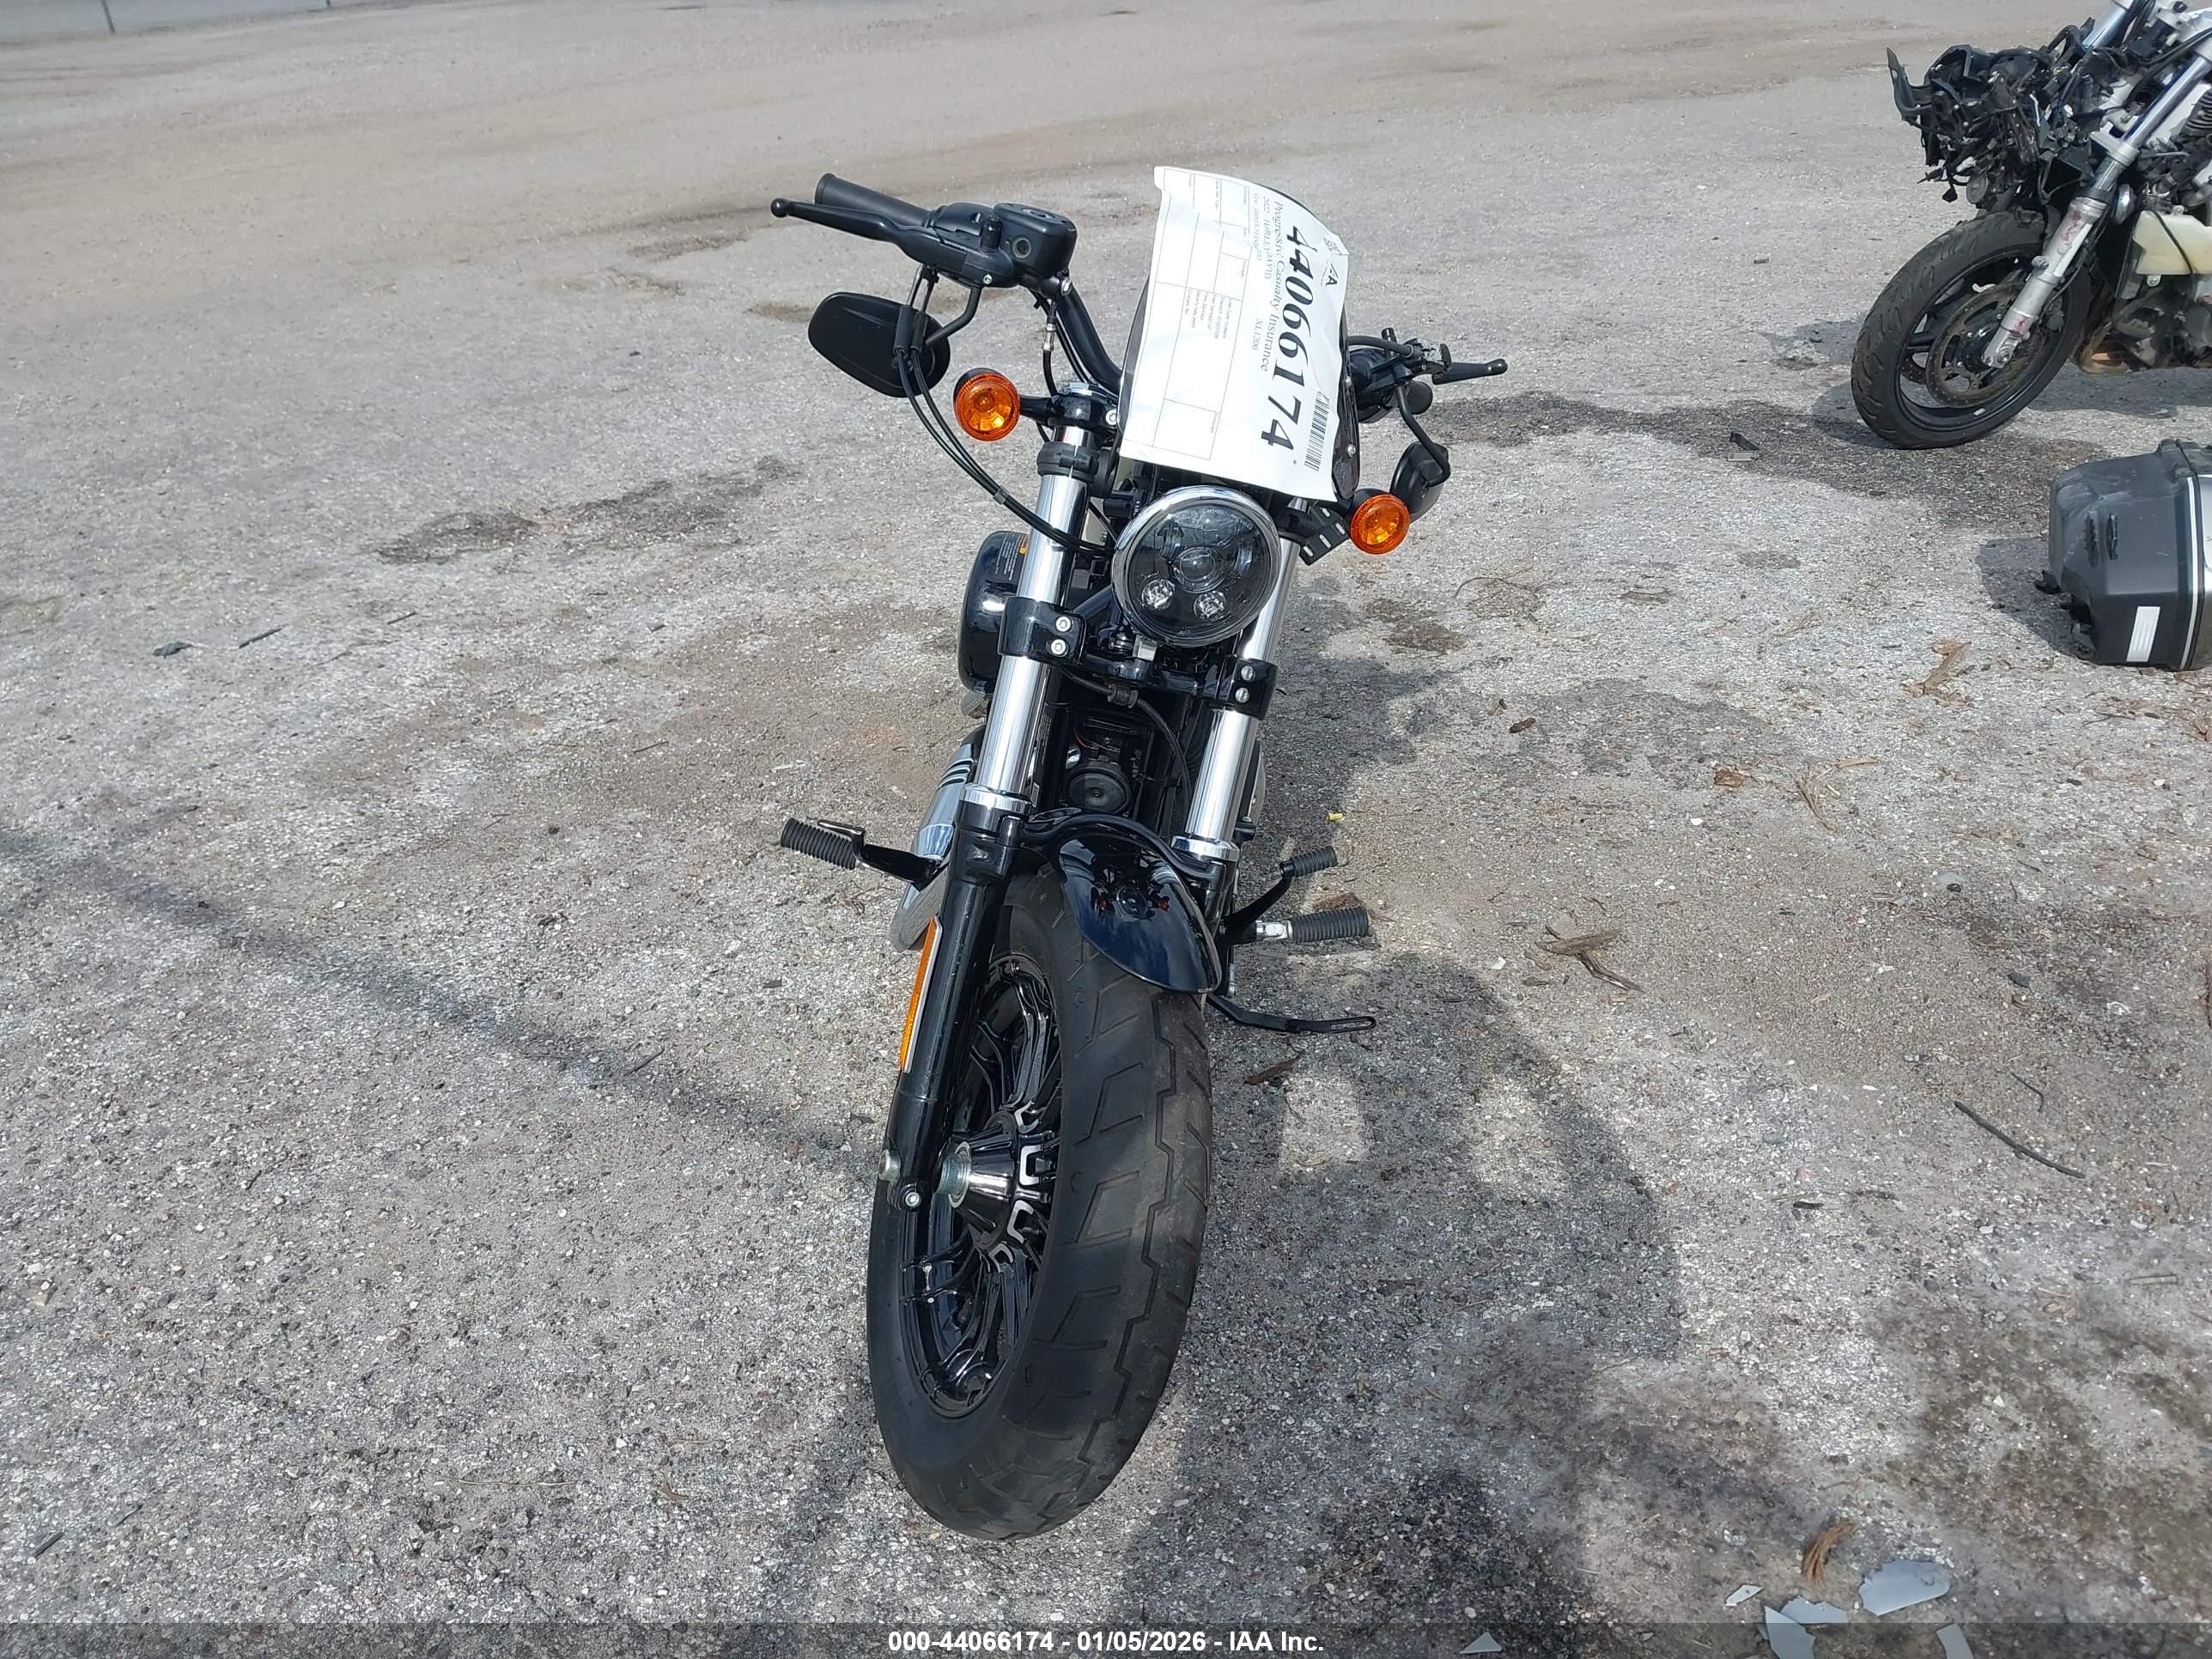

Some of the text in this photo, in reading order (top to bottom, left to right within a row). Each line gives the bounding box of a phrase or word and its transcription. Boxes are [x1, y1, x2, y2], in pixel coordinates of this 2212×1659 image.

[1270, 260, 1286, 311] Casualty
[1250, 318, 1264, 351] XL1200
[1261, 225, 1318, 451] 44066174
[1261, 313, 1279, 372] Insurance
